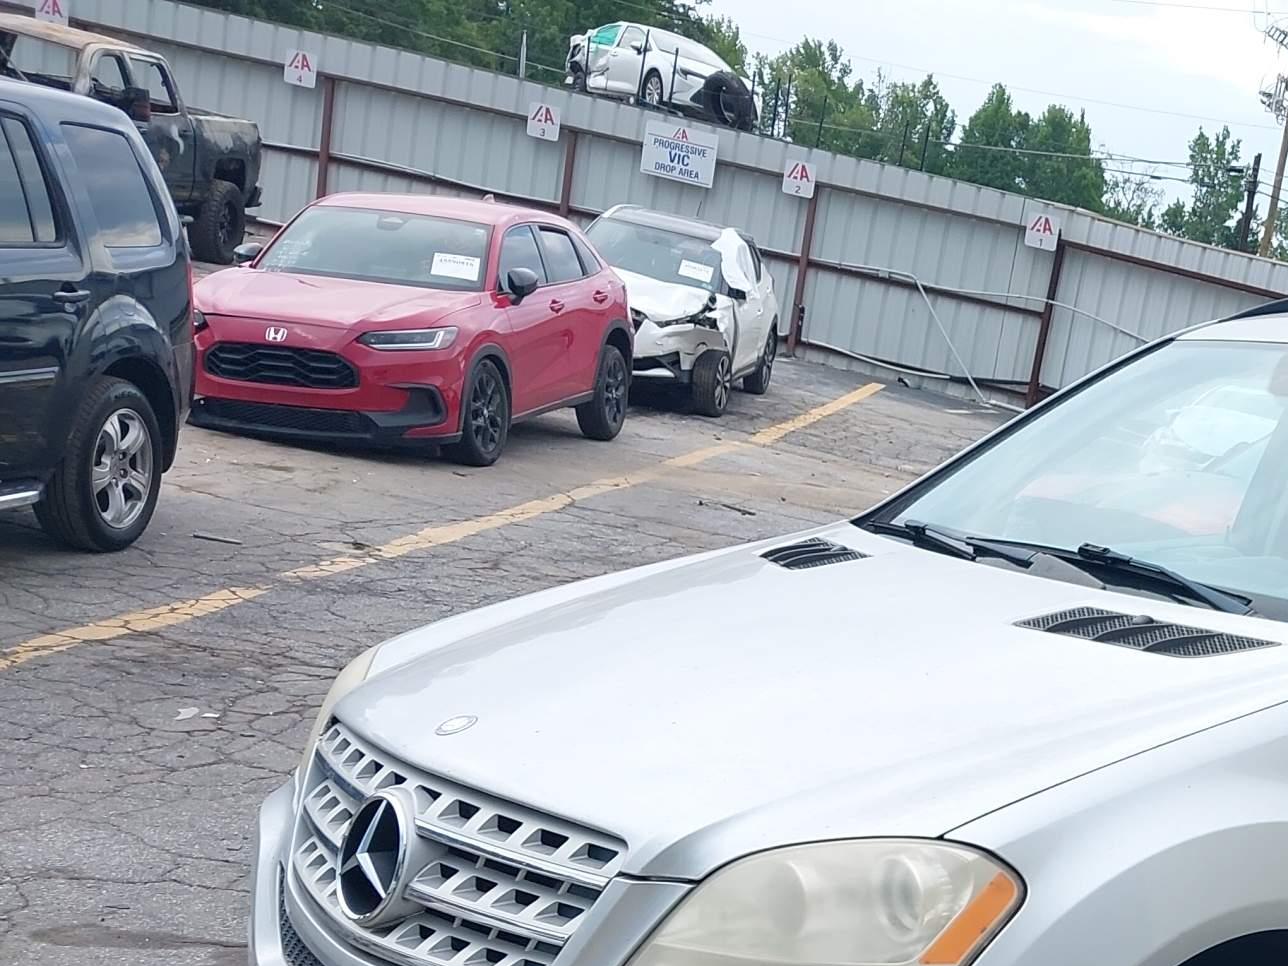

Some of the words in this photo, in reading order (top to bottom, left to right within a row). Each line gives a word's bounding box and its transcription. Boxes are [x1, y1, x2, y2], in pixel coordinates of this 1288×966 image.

[296, 75, 303, 84] 4
[539, 128, 546, 137] 3
[653, 137, 708, 158] PROGRESSIVE
[668, 150, 691, 167] VIC
[654, 161, 677, 174] DROP
[678, 167, 700, 180] AREA
[794, 185, 802, 195] 2
